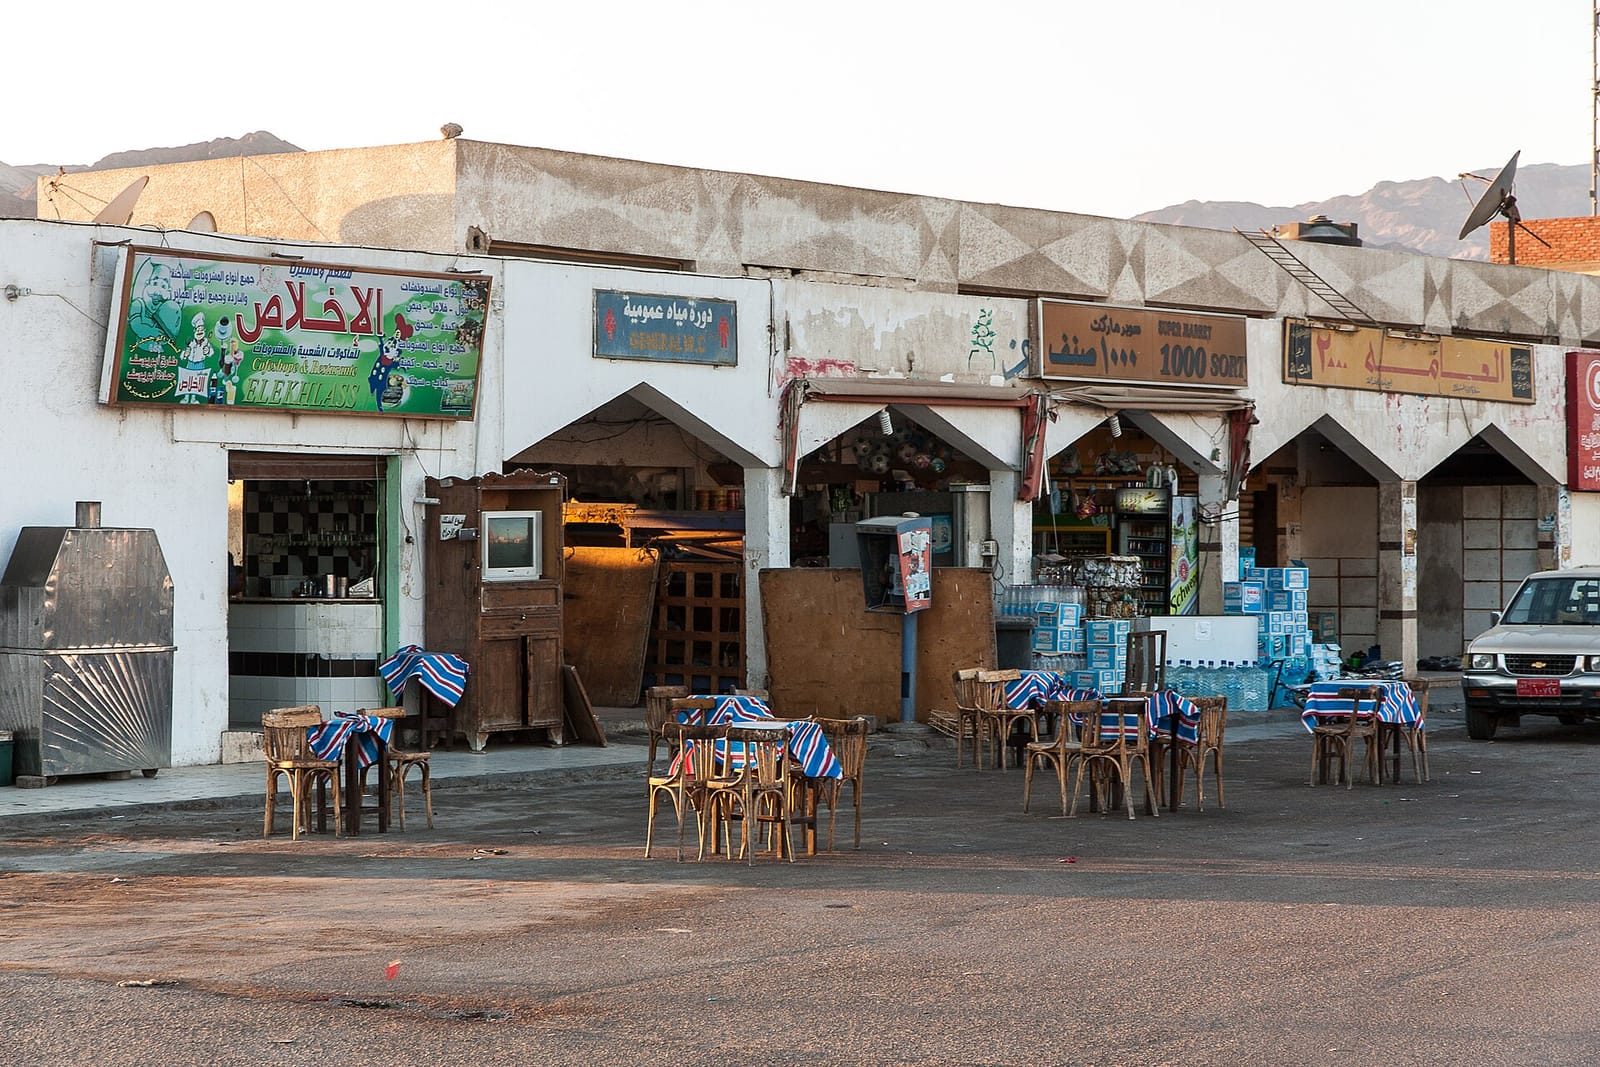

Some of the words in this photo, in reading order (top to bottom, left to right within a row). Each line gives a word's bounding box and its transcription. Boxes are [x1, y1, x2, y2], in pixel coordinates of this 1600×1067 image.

[194, 270, 225, 284] المشروبات
[240, 275, 255, 286] جميع
[236, 281, 383, 347] الإخلاص
[623, 295, 664, 324] عمومية
[666, 301, 688, 327] مياه
[689, 300, 713, 329] دورة
[1090, 315, 1121, 336] ماركت
[1121, 323, 1142, 337] سوبر
[1158, 319, 1182, 338] SUPER
[1182, 323, 1212, 341] MARKET
[252, 342, 296, 357] والمشروبات
[298, 345, 326, 359] الشعبية
[629, 332, 682, 352] GENERAL
[1048, 334, 1097, 366] صنف
[300, 360, 308, 374] &
[1160, 343, 1207, 379] 1000
[1210, 352, 1247, 379] SORT
[241, 378, 360, 408] ELEKHLASS
